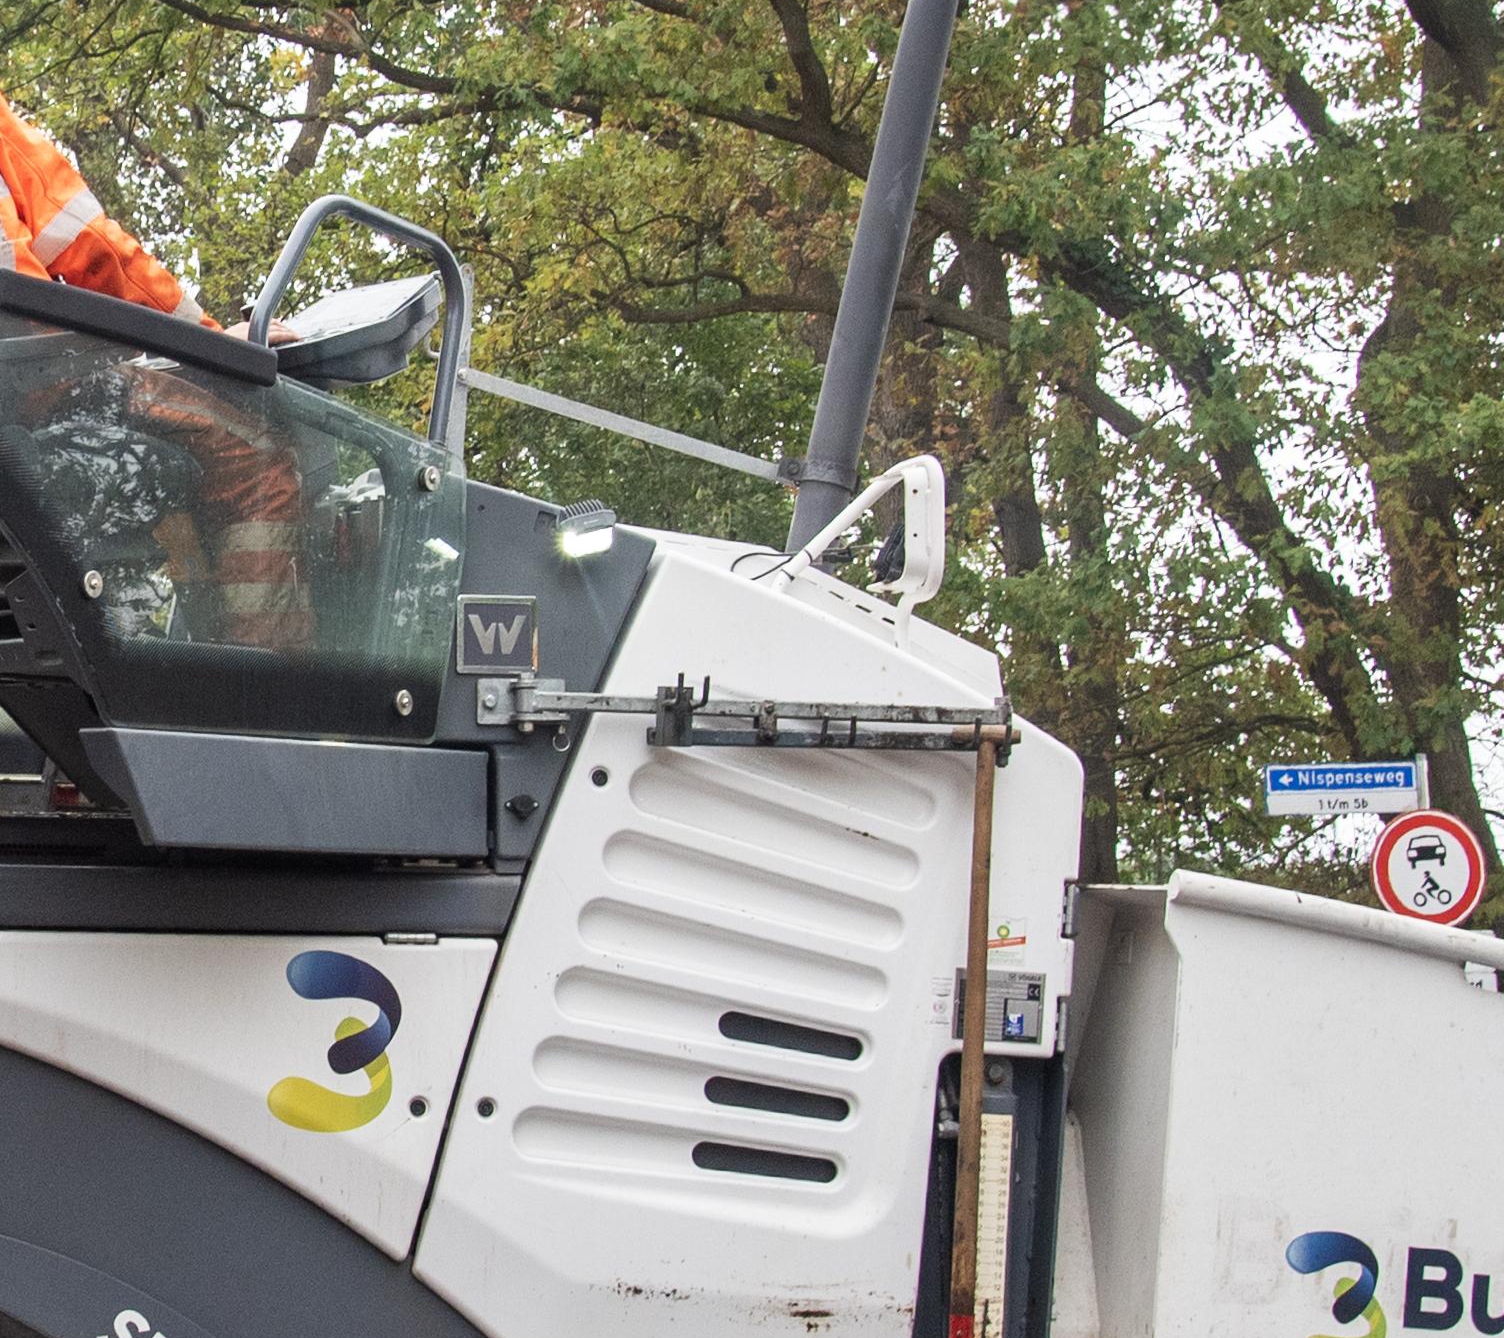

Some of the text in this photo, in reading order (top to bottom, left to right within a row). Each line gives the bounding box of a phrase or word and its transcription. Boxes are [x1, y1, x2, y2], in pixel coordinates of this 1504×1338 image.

[1298, 770, 1405, 787] Nispenseweg
[1327, 799, 1349, 809] t/m
[1354, 798, 1369, 809] 5b
